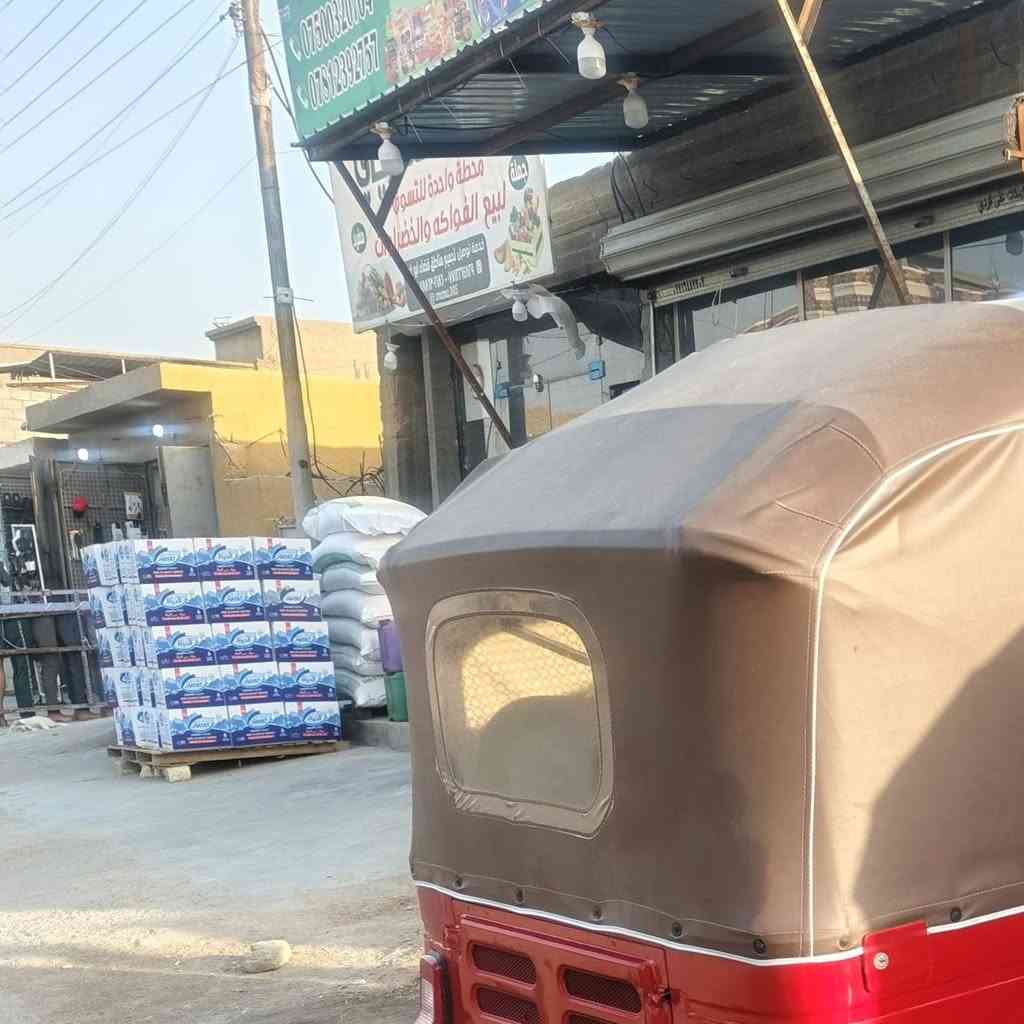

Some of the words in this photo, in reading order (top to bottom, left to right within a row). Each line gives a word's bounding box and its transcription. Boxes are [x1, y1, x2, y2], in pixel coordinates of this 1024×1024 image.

[428, 168, 455, 198] واحدة
[483, 180, 507, 230] لبيع
[433, 192, 479, 236] الفواكه
